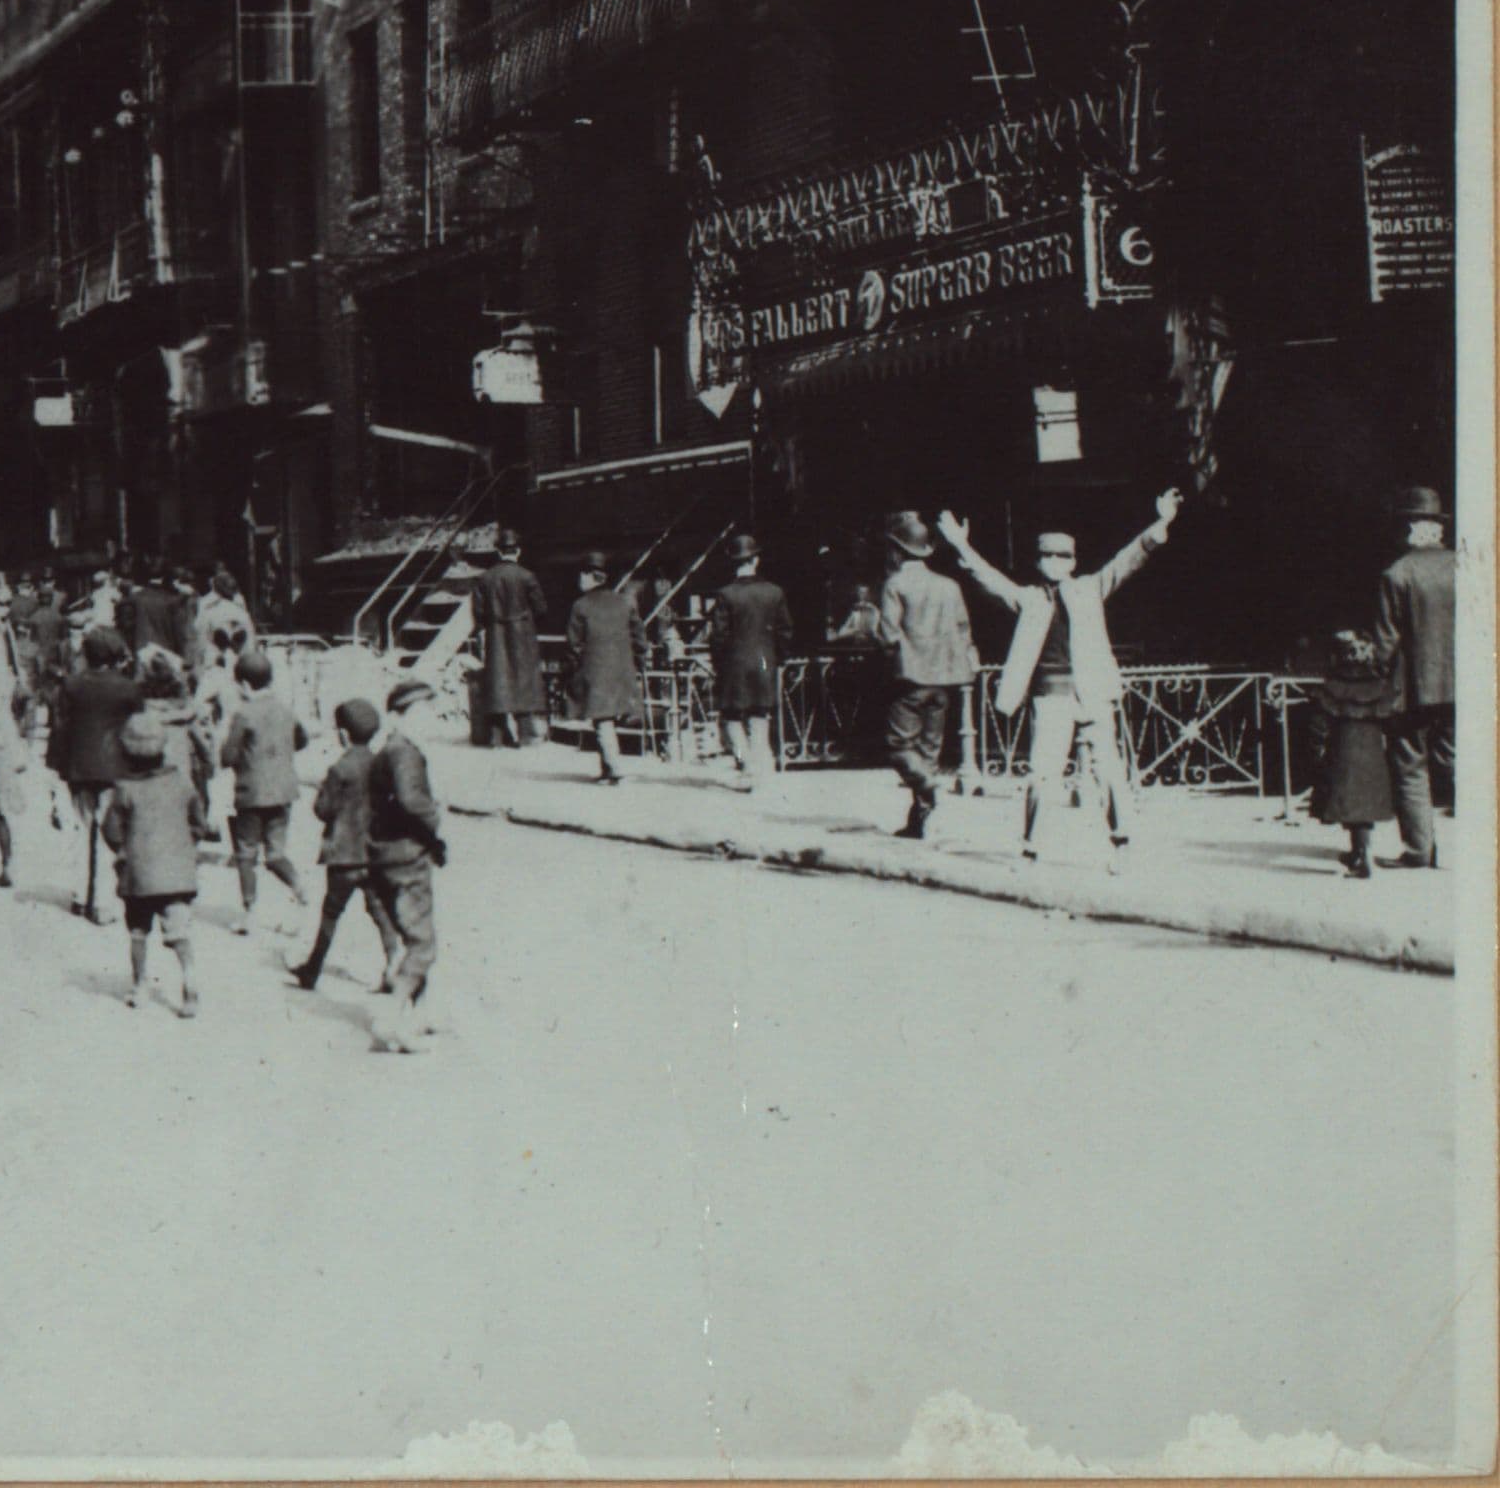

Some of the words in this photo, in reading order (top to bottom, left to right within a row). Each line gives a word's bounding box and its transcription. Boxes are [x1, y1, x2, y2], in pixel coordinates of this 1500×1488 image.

[1372, 216, 1453, 235] ROASTERS
[1119, 226, 1154, 266] 6
[889, 250, 991, 313] SUPERB
[999, 232, 1073, 287] BEER
